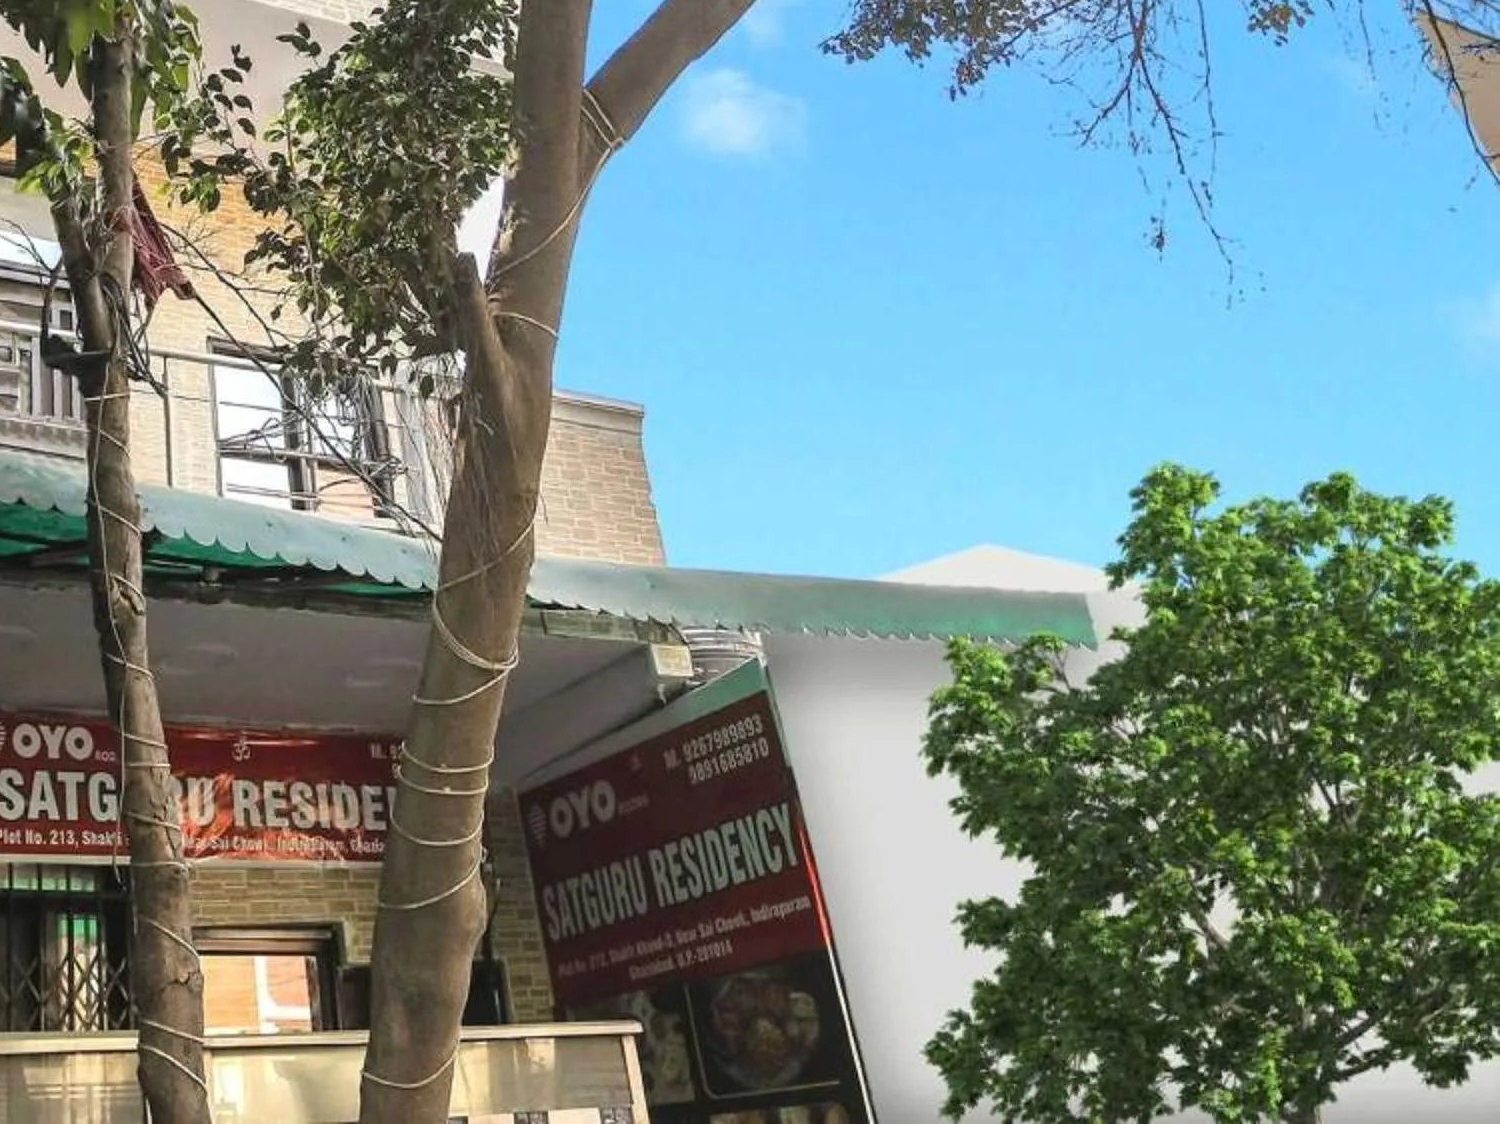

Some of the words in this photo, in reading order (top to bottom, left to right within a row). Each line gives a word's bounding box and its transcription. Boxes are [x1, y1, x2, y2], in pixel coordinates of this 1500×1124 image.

[12, 723, 94, 761] OYO
[550, 778, 617, 838] OYO
[25, 829, 47, 845] No.
[51, 830, 79, 848] 213,
[543, 855, 648, 941] SATGURU
[648, 803, 799, 908] RESIDENCY
